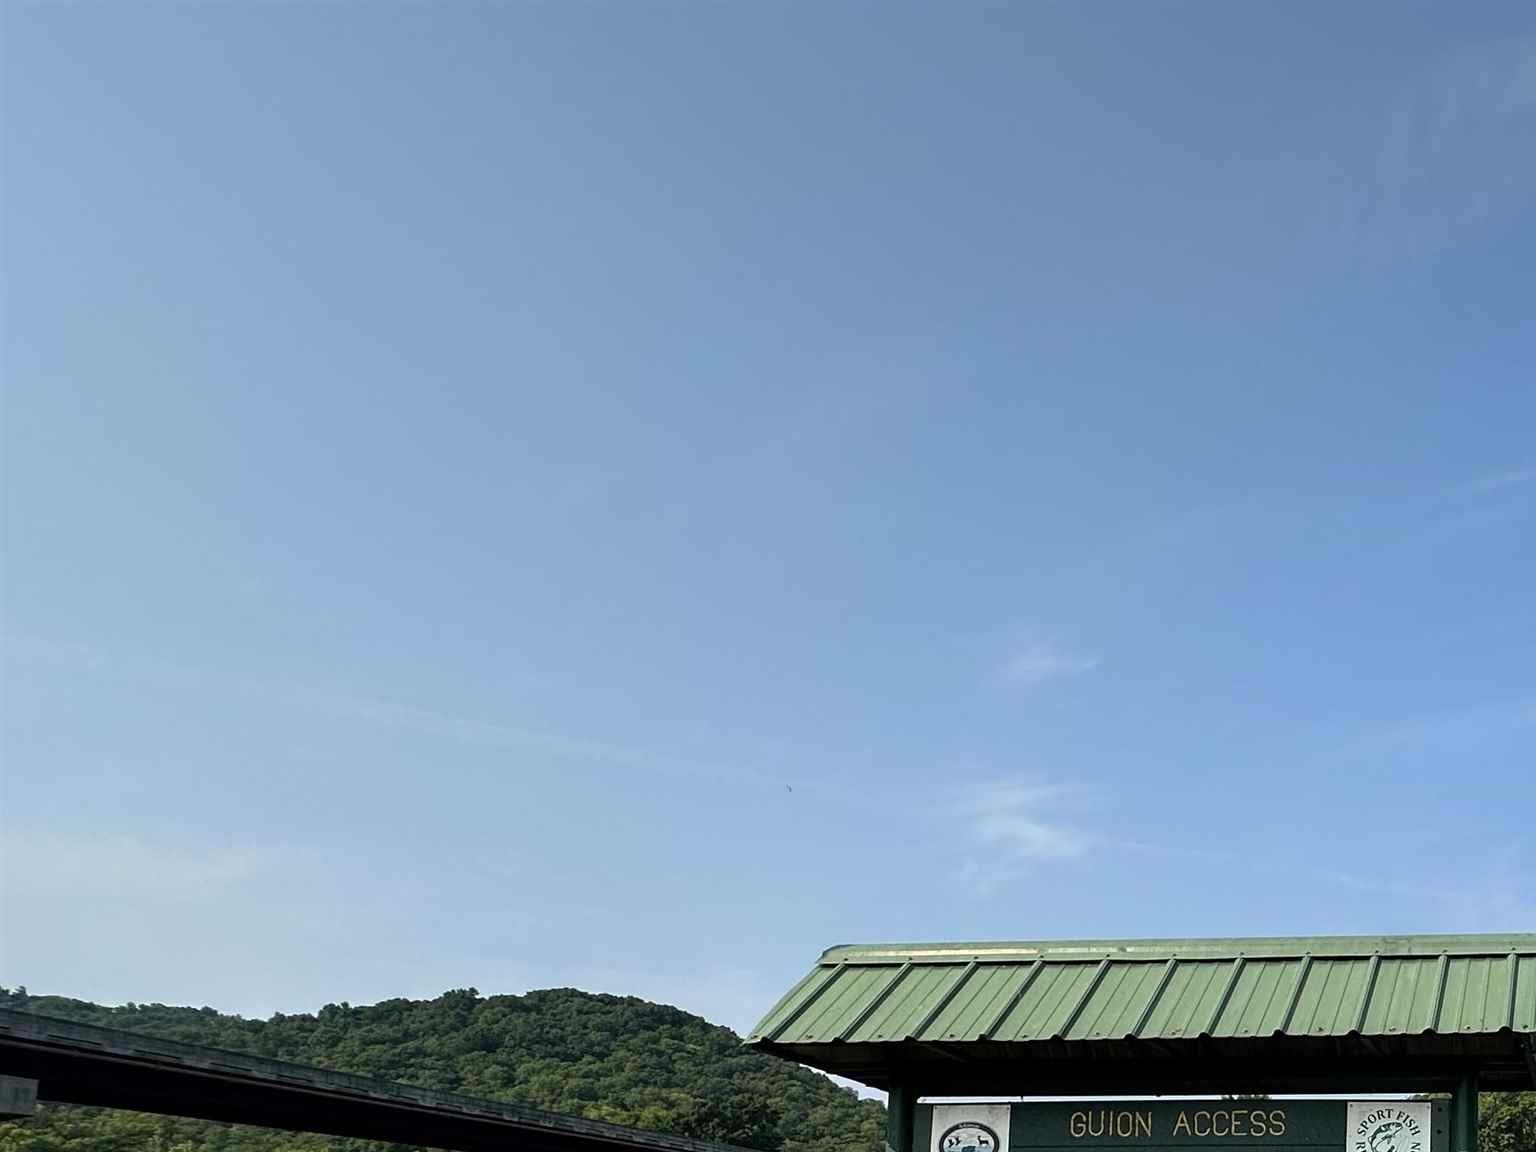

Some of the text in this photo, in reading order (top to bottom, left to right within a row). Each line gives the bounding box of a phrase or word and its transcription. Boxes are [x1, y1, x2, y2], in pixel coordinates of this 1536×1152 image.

[1070, 1110, 1286, 1138] GUION ACCESS
[1357, 1108, 1421, 1136] SPORT FISH
